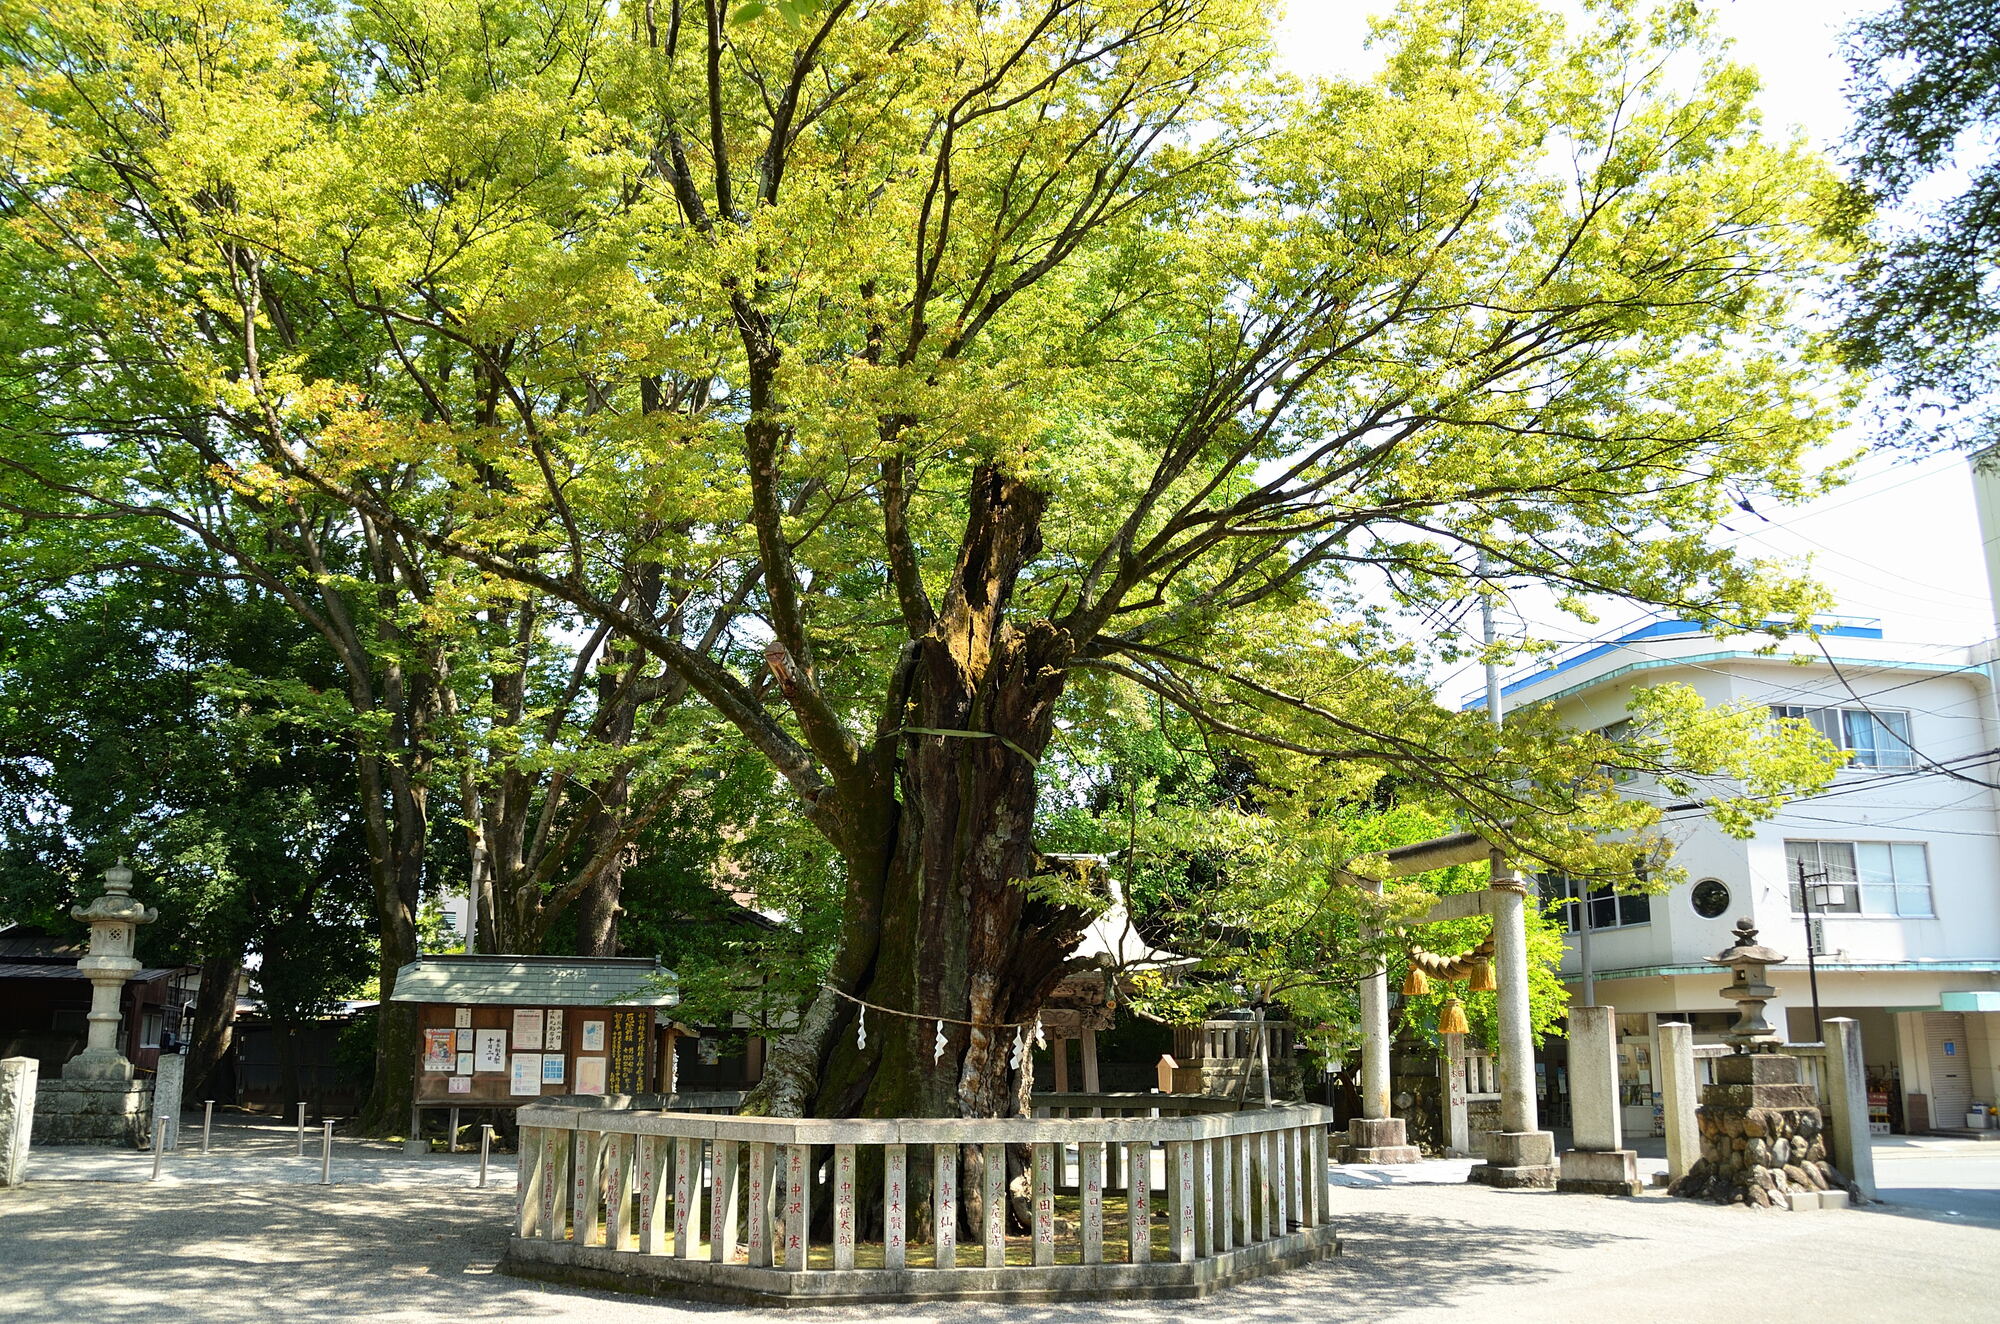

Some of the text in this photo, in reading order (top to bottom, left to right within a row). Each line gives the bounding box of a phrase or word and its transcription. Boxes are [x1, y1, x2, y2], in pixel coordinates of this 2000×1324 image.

[789, 1183, 801, 1249] 中沢実
[839, 1182, 852, 1247] 中沢保太郎
